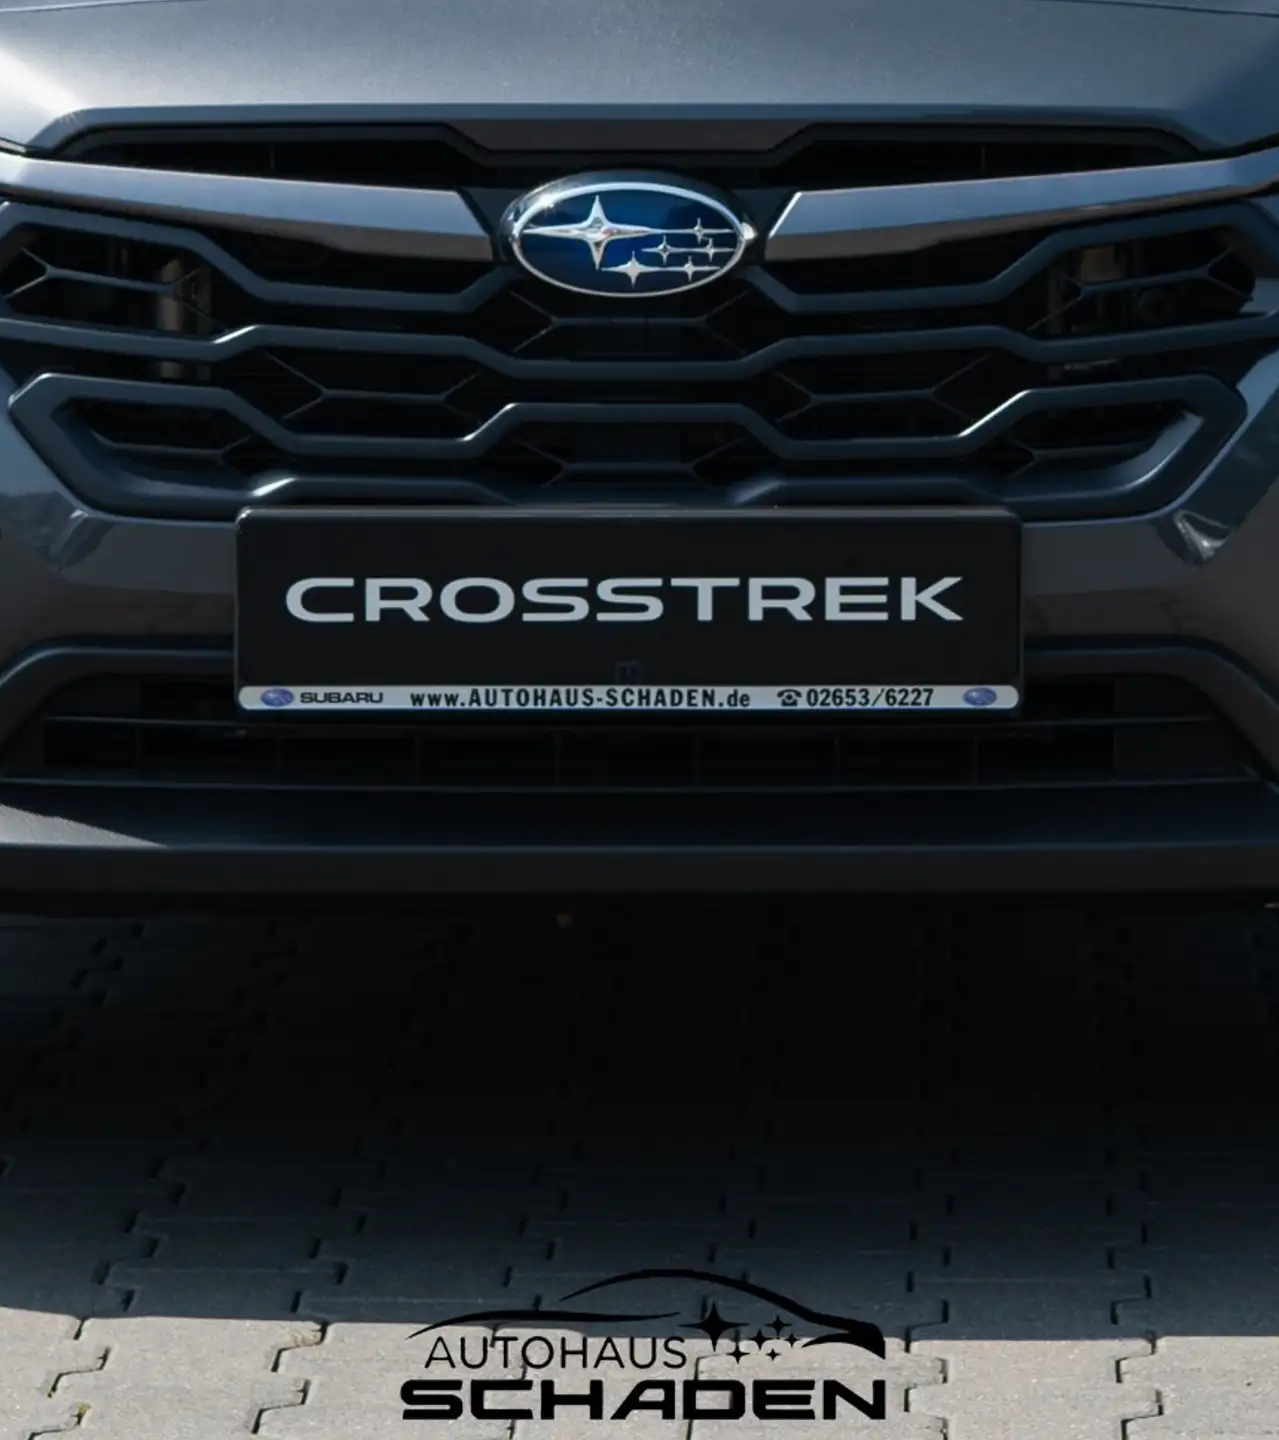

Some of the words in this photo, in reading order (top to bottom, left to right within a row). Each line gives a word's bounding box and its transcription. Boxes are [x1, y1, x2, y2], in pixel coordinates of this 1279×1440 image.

[285, 576, 964, 623] CROSSTREK
[299, 692, 384, 704] SUBARU
[409, 687, 752, 708] www.AUTOHAUS-SCHADEN.de
[805, 687, 935, 708] 02653/6227
